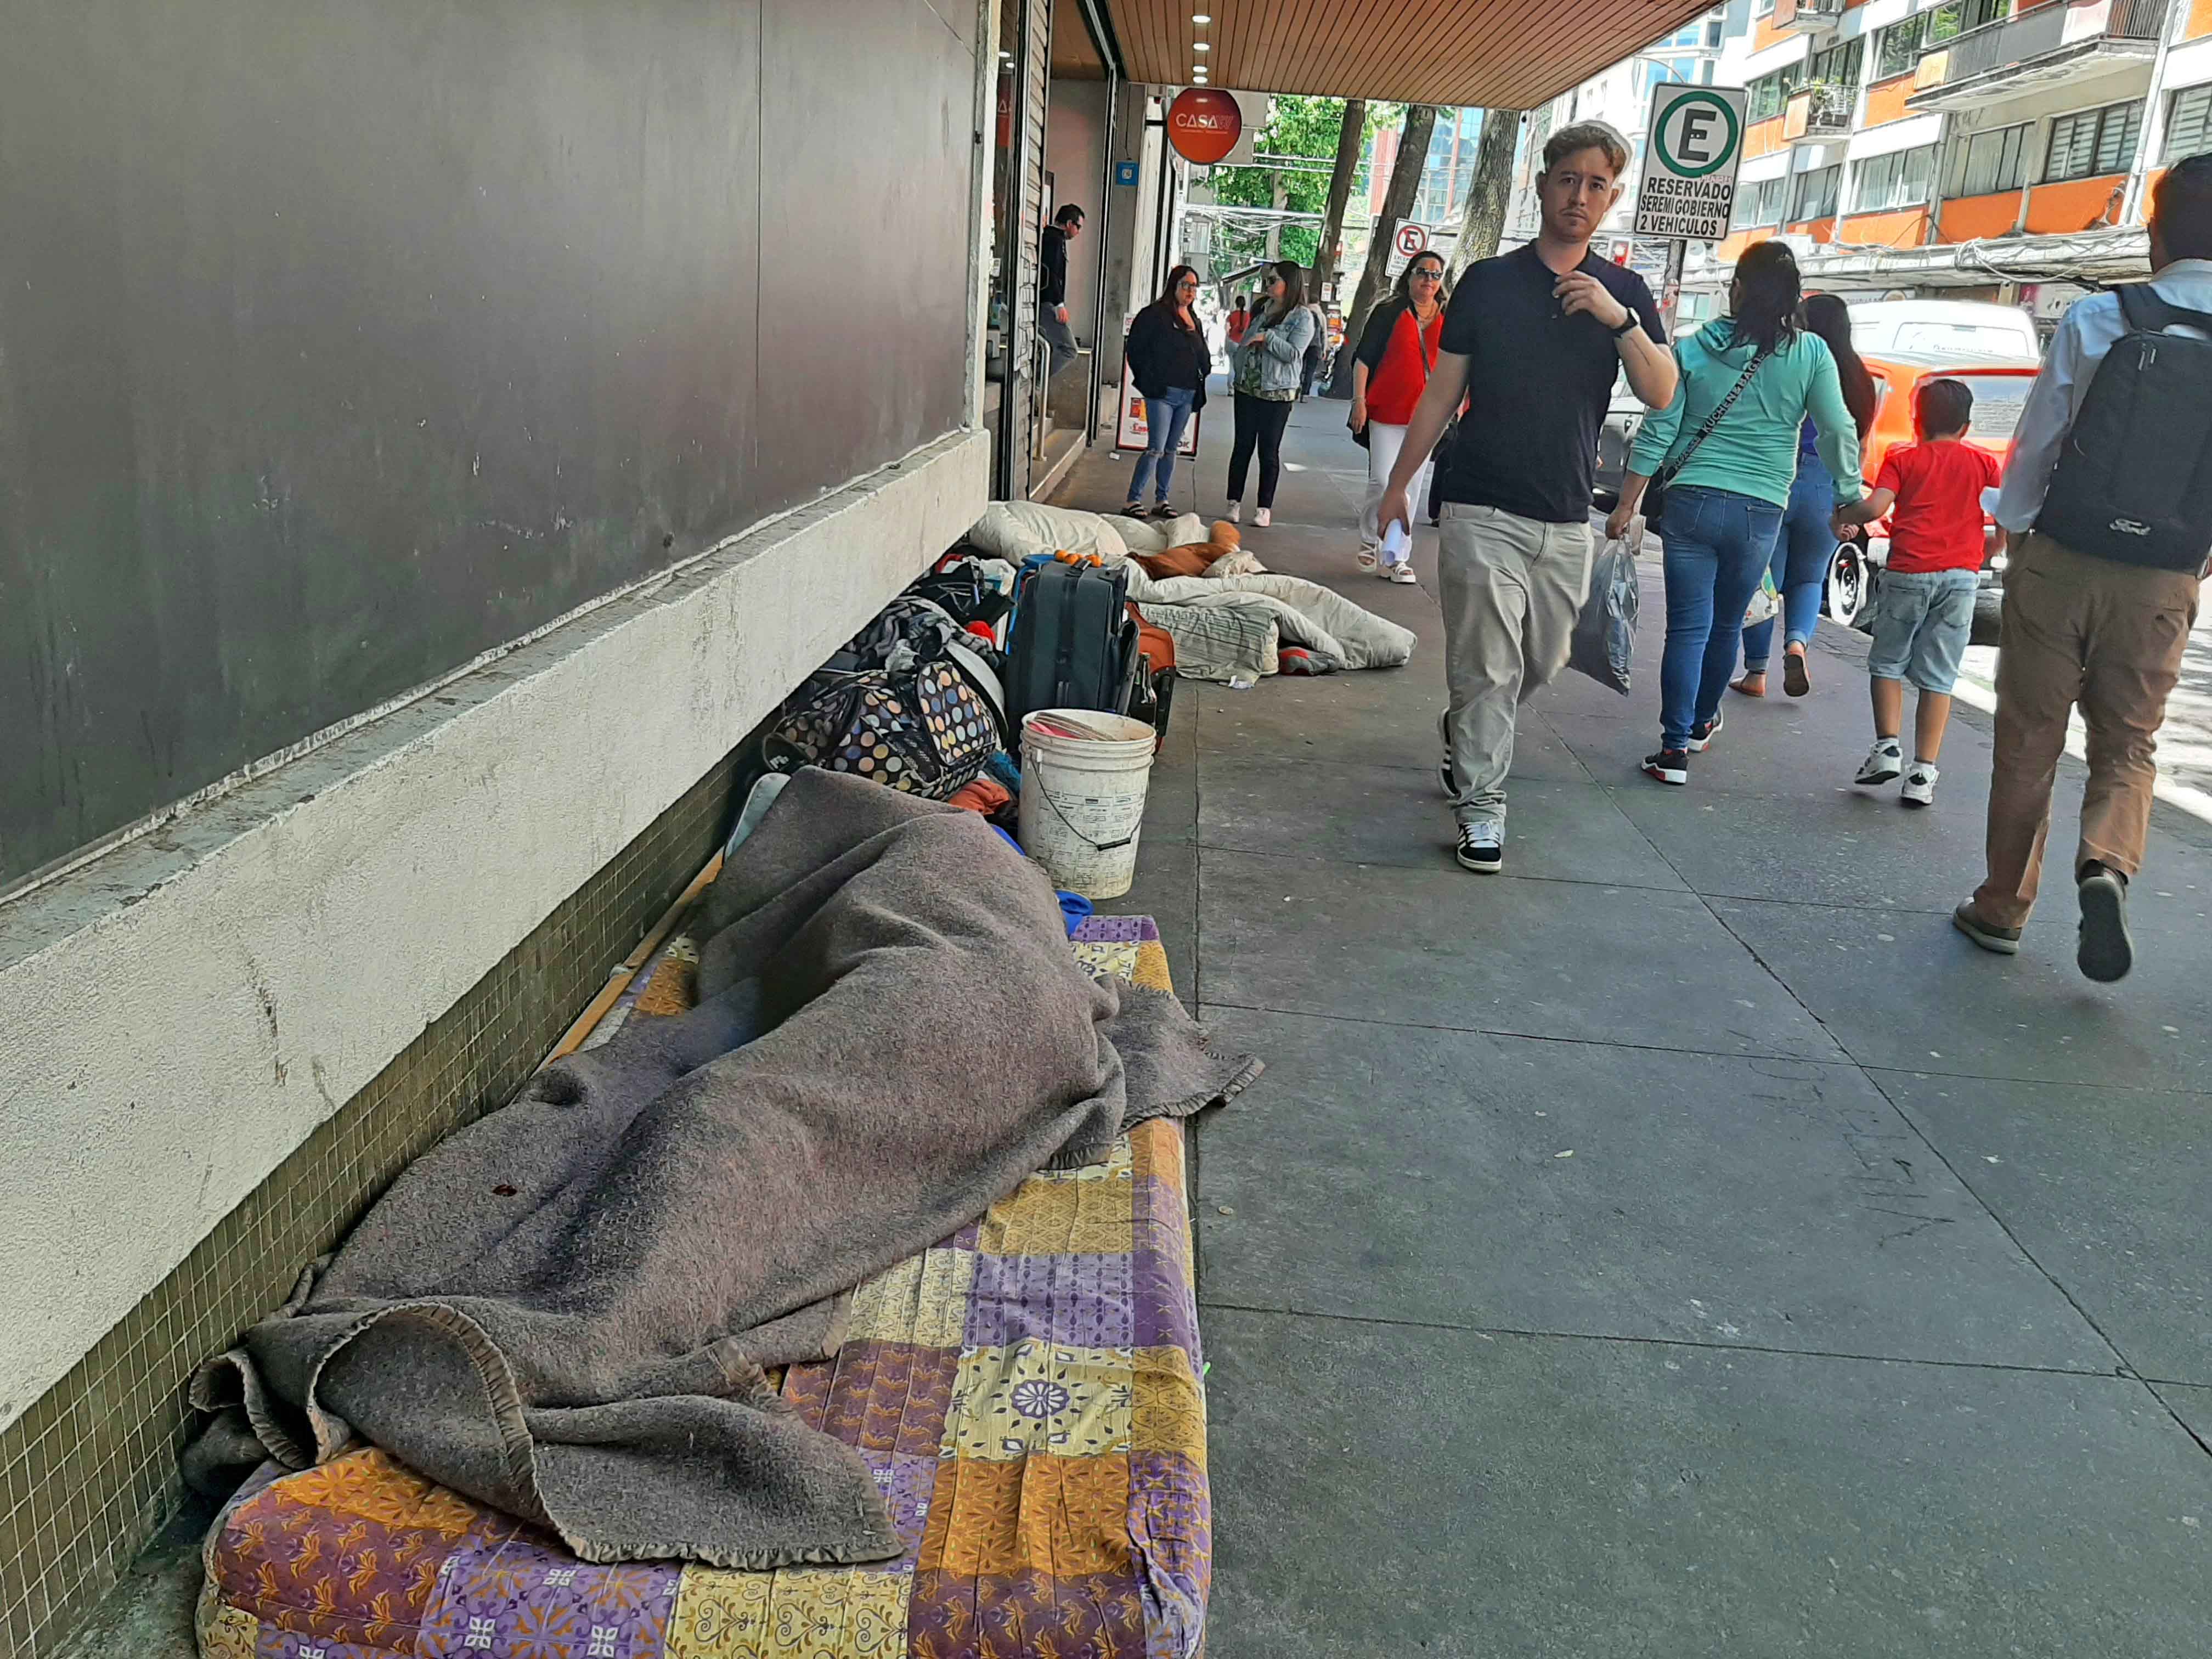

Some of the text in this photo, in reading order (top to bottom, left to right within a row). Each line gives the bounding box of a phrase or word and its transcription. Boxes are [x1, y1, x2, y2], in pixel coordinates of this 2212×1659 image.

[1677, 108, 1717, 162] E
[1646, 177, 1731, 201] RESERVADO
[1640, 195, 1730, 219] SEREMI GOBIERNO
[1640, 215, 1718, 236] 2 VEHICULOS
[2109, 518, 2151, 535] Ford
